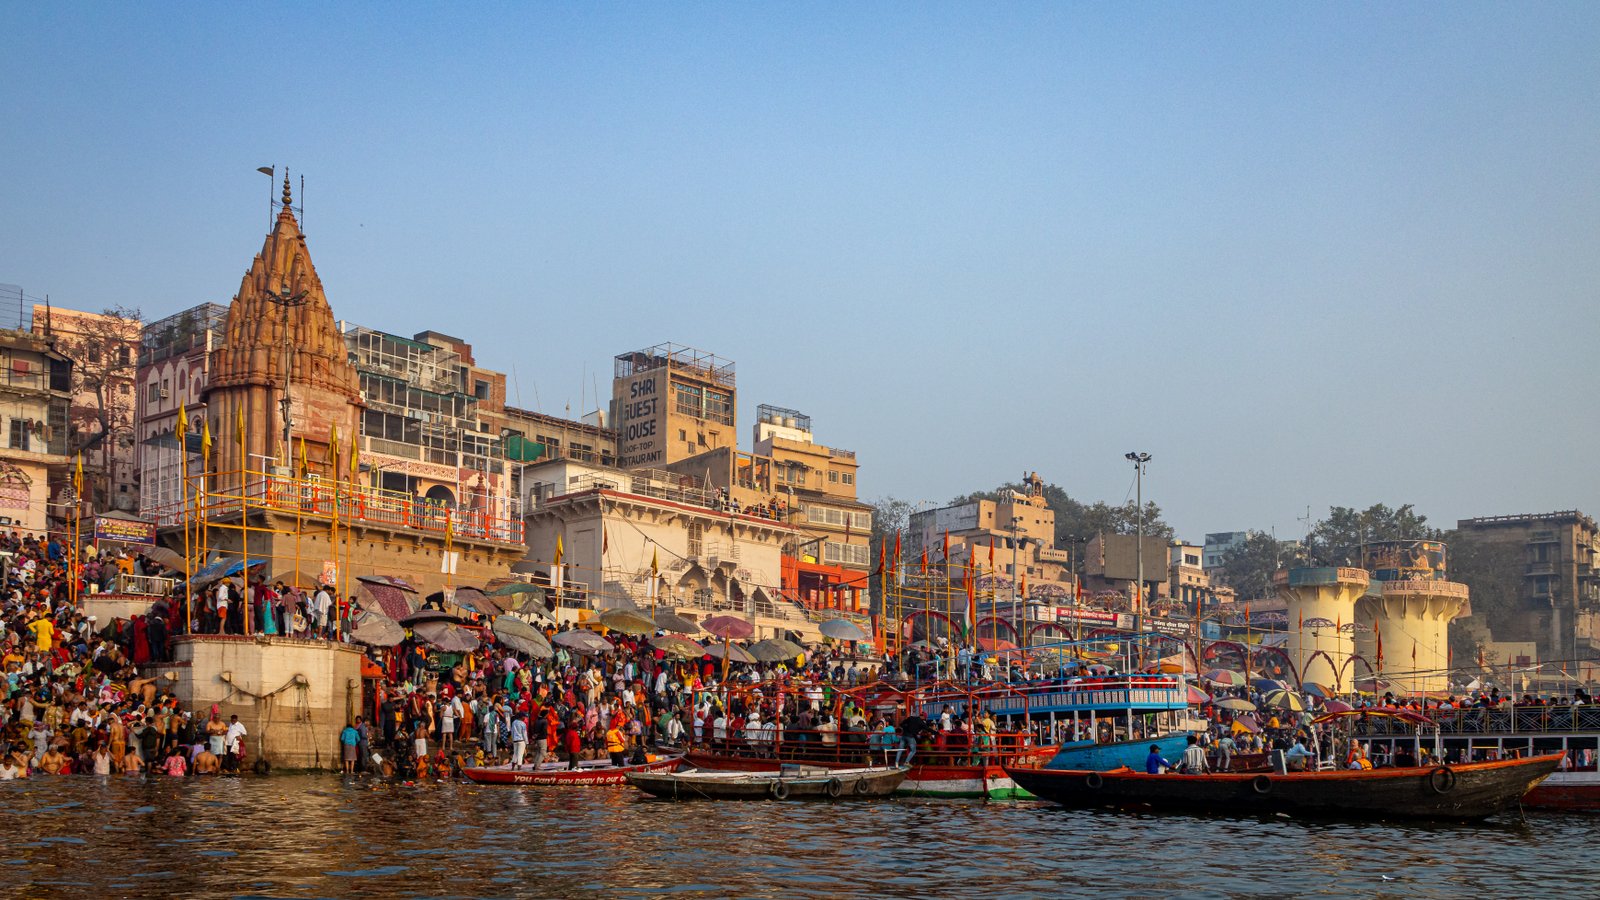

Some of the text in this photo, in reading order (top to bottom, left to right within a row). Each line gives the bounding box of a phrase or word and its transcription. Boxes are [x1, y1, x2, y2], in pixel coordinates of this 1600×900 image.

[631, 378, 655, 398] SHRI
[623, 450, 662, 467] STAURANT
[596, 776, 605, 784] to
